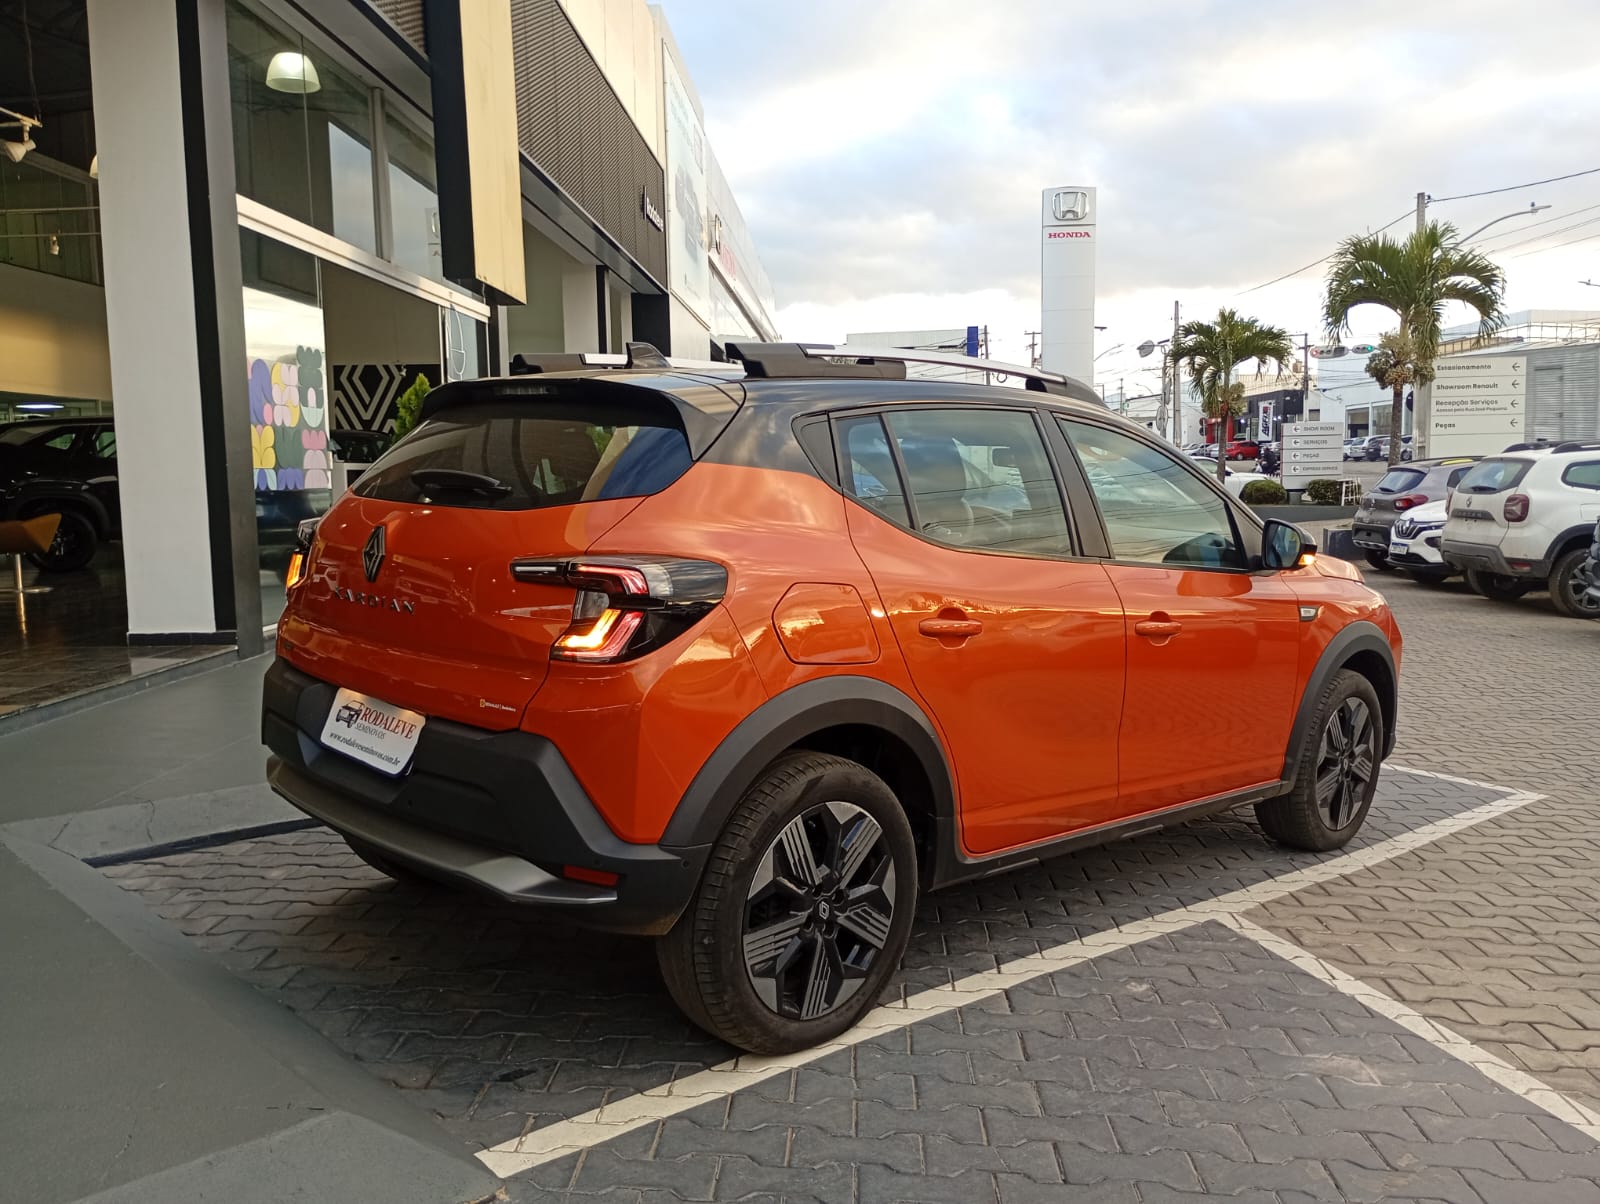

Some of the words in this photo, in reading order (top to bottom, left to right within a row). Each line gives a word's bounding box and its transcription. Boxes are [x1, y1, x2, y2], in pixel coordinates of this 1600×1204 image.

[1047, 231, 1092, 239] HONDA
[335, 586, 415, 615] KARDIAN
[355, 723, 387, 740] SEMINOVOS
[360, 706, 417, 740] RODALEVE
